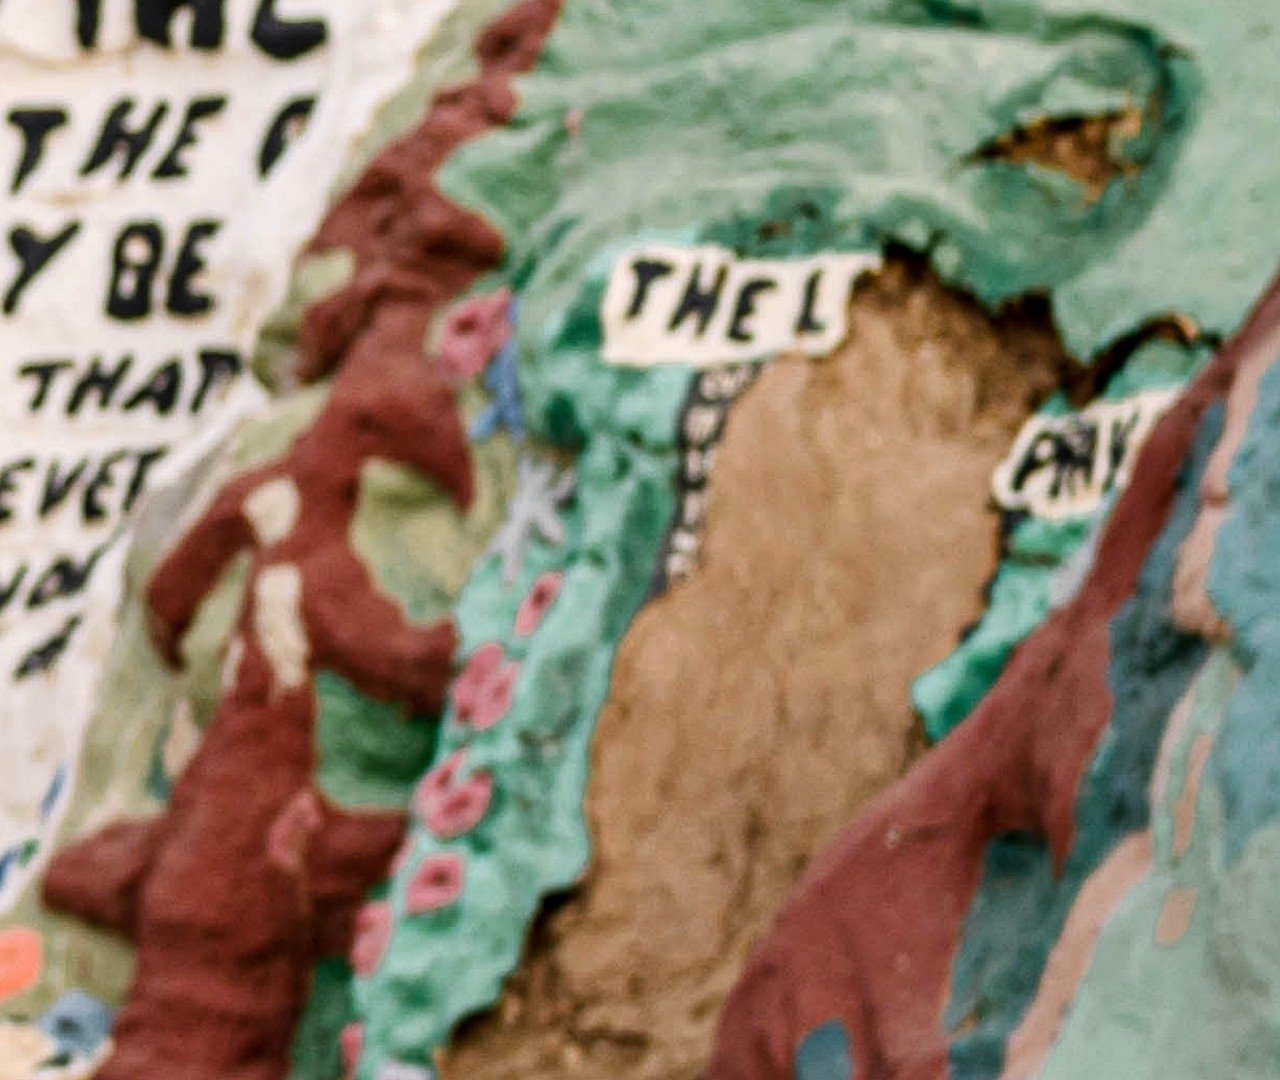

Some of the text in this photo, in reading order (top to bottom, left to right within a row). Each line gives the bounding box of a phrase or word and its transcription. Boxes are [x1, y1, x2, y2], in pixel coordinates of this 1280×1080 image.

[76, 95, 230, 182] HE
[103, 219, 225, 323] BE
[624, 258, 777, 342] THE
[16, 348, 243, 416] THAT
